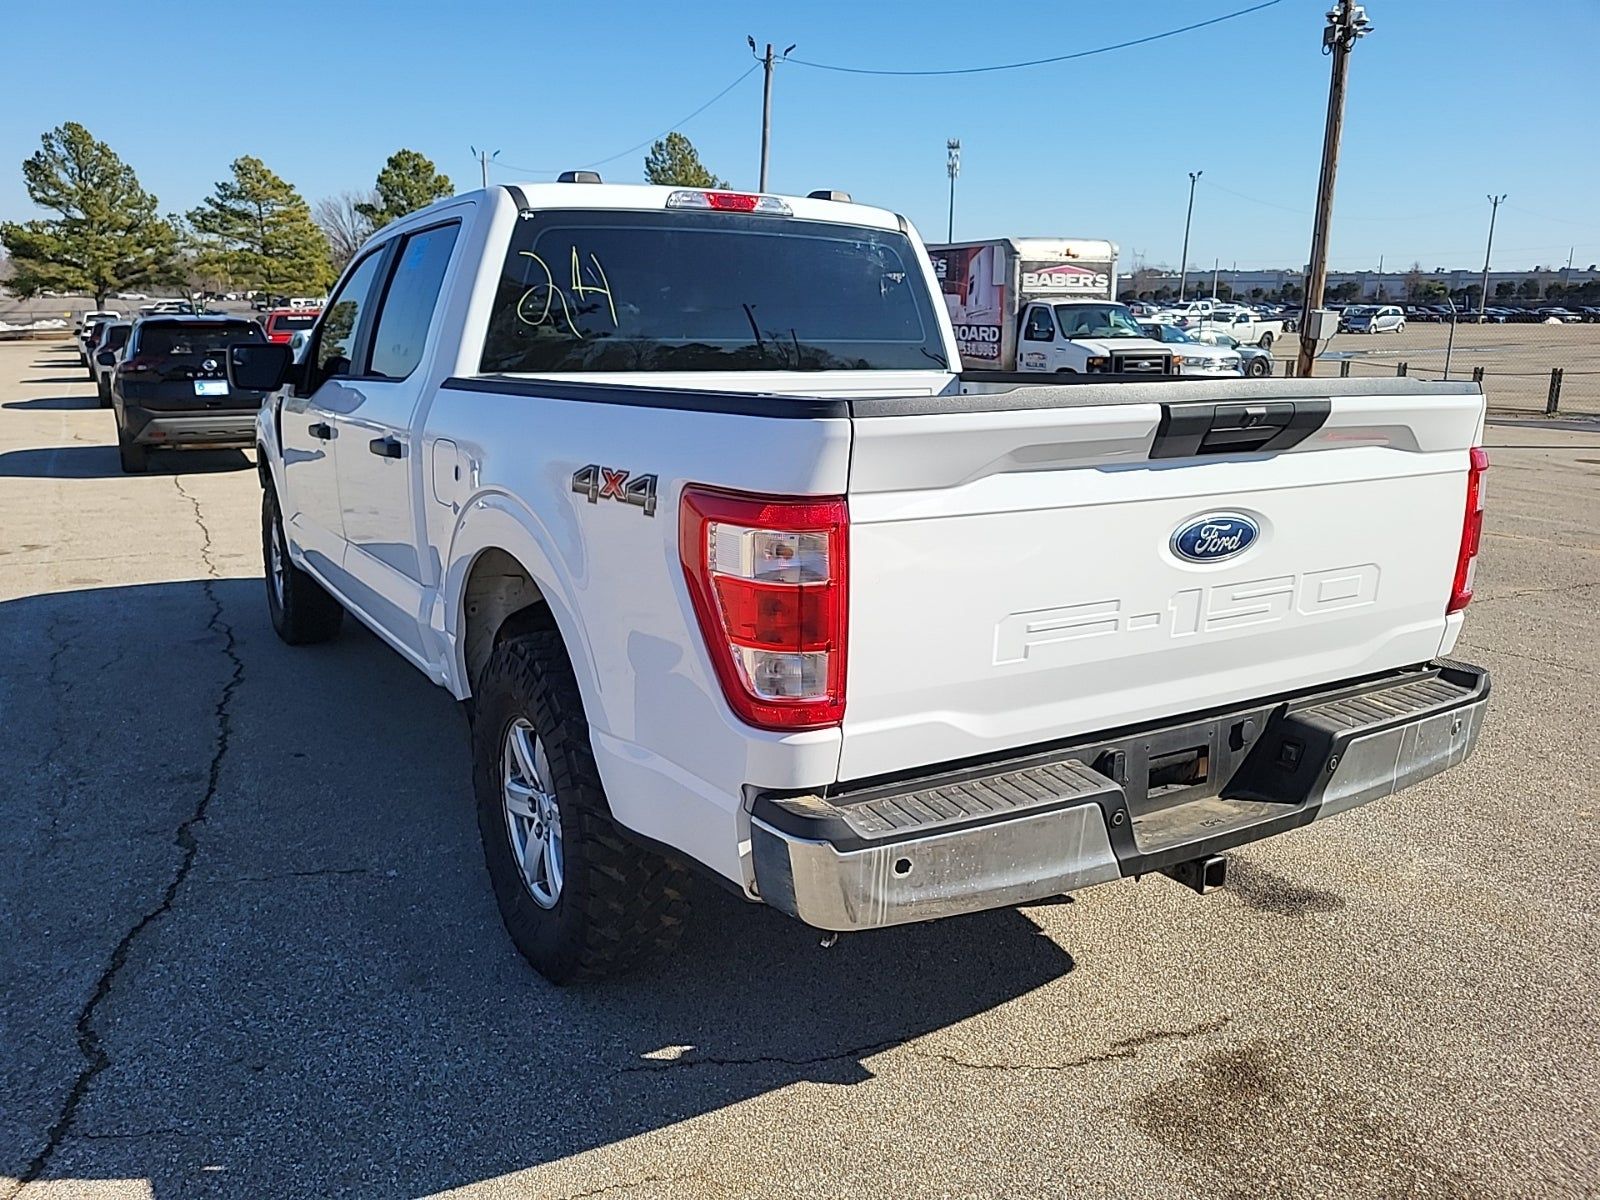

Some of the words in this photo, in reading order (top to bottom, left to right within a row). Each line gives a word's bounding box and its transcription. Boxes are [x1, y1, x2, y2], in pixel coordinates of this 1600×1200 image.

[517, 246, 619, 339] 24
[1022, 272, 1109, 287] BABER'S
[1194, 523, 1243, 555] Ford
[992, 563, 1381, 666] F-150
